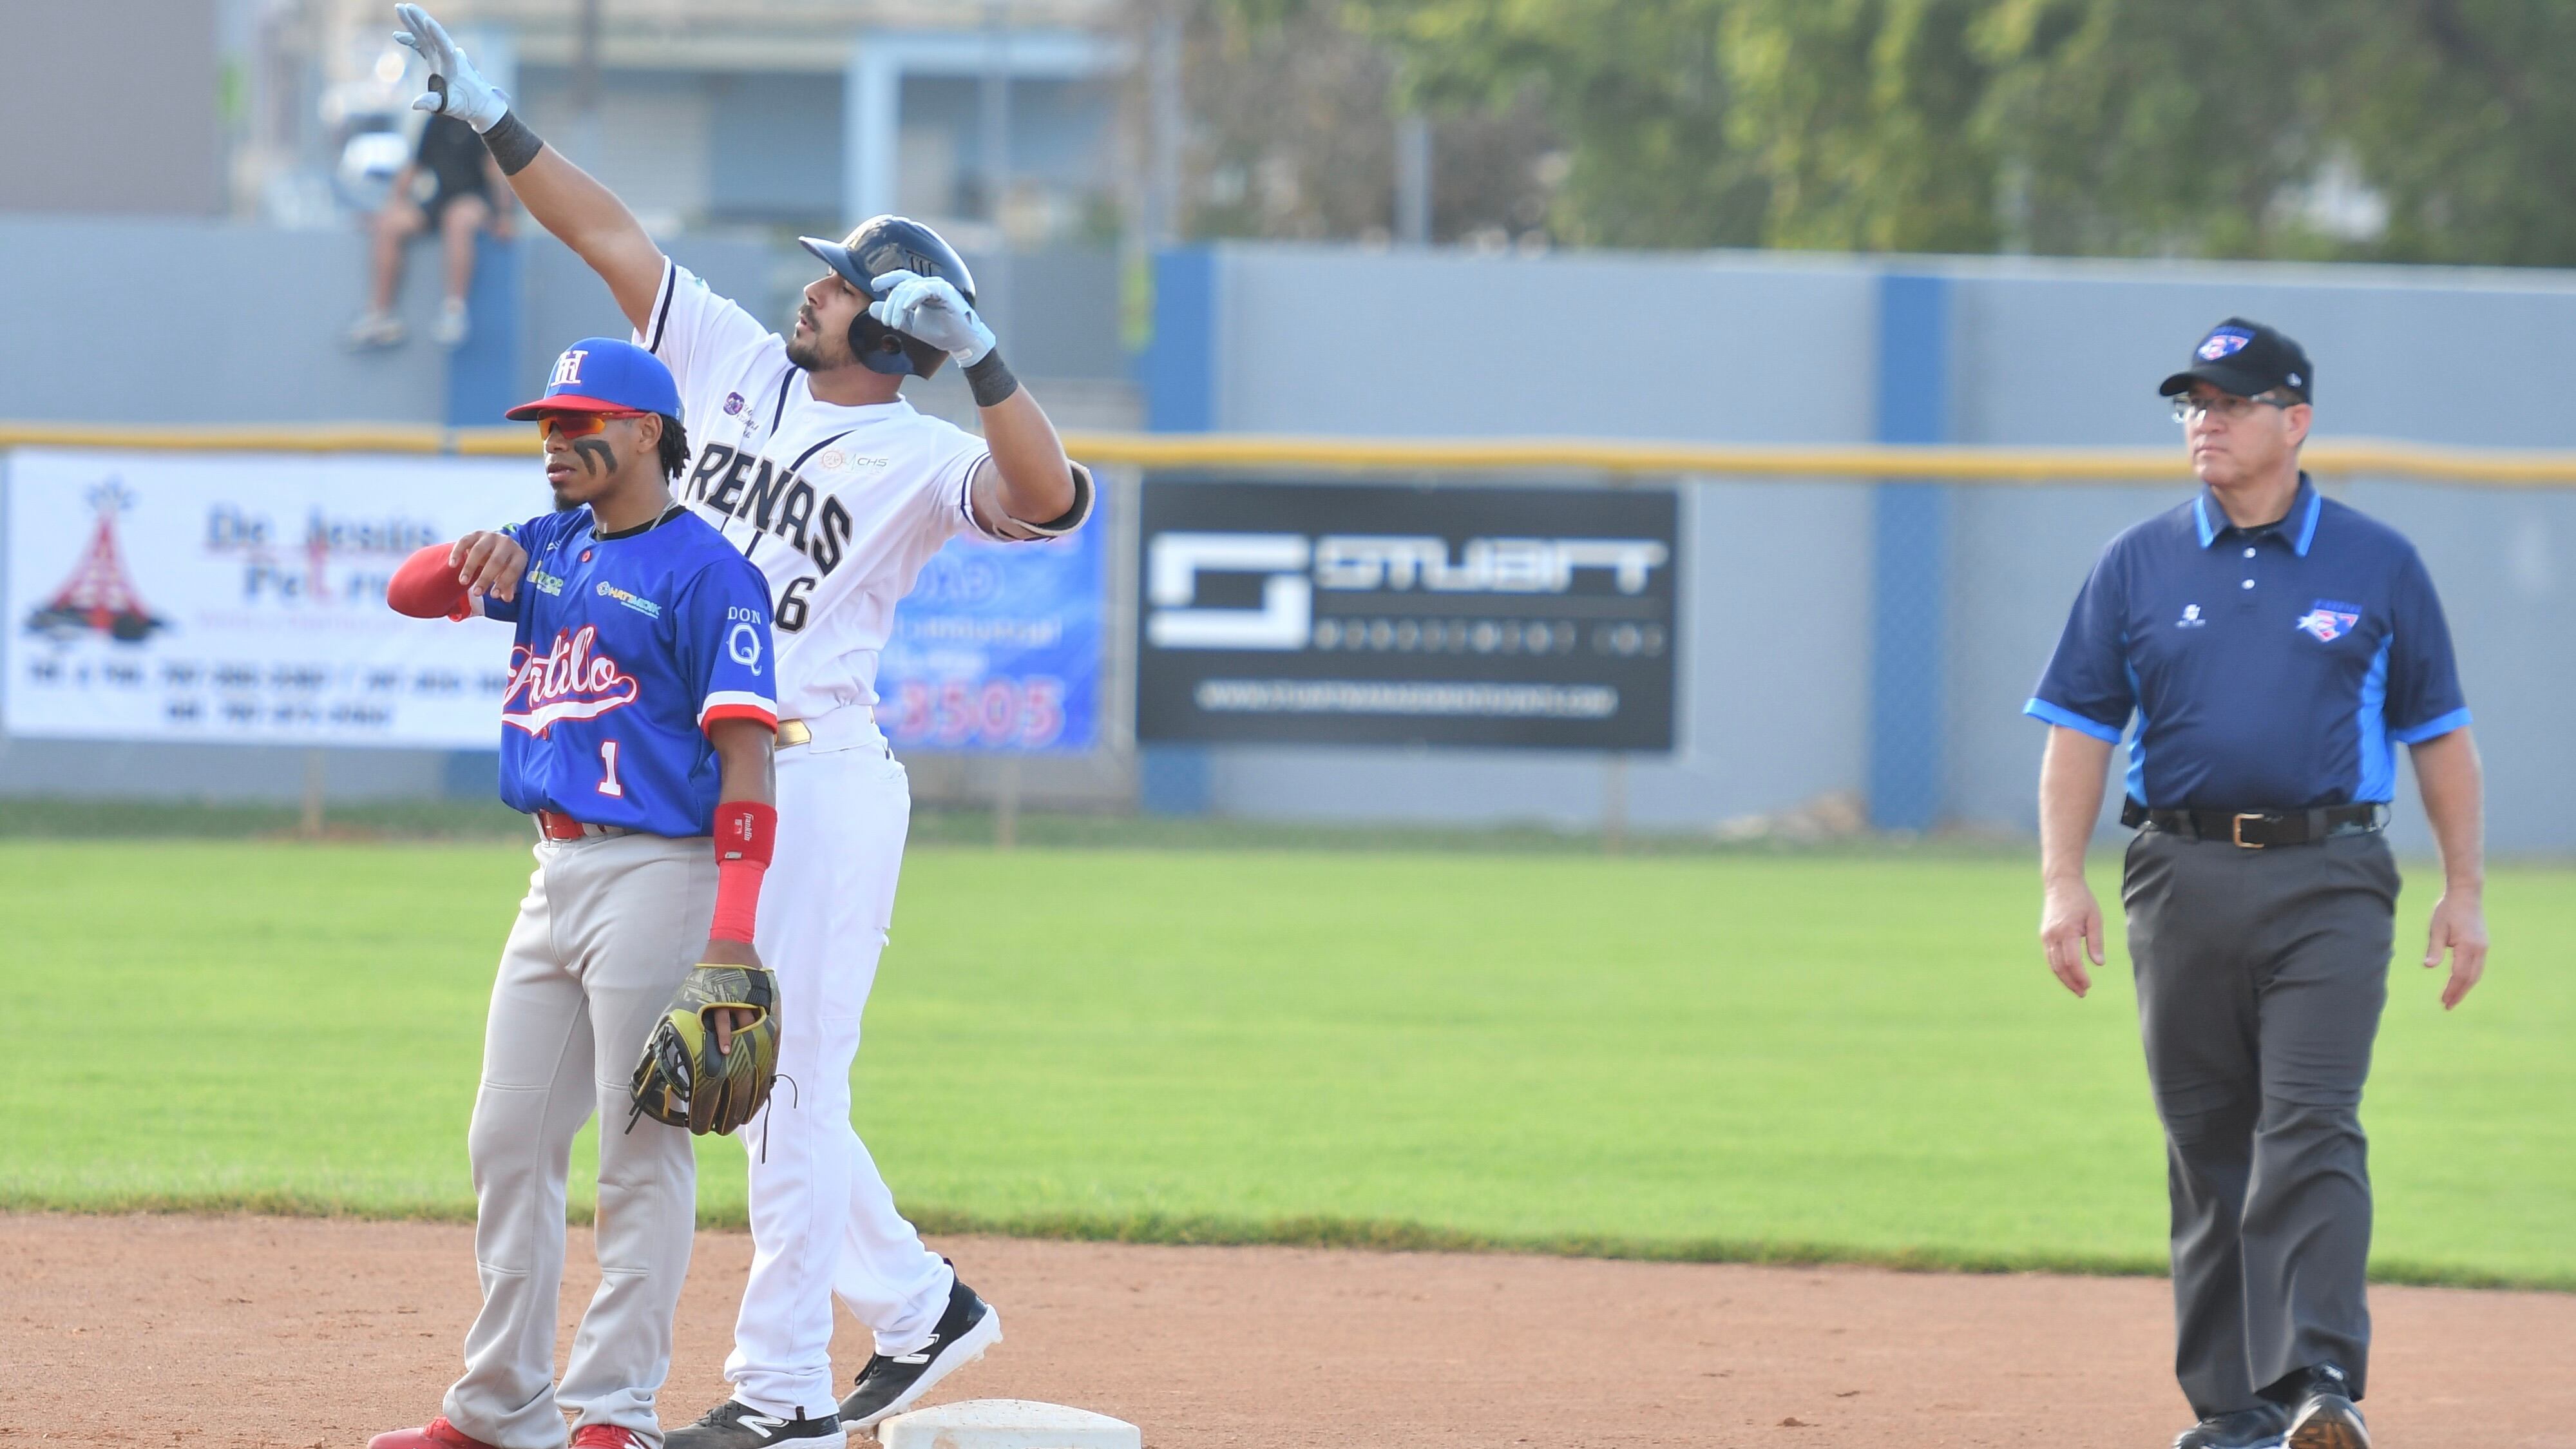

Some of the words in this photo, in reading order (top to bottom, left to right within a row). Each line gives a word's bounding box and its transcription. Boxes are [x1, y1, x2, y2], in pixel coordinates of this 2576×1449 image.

[728, 606, 761, 625] DON
[773, 575, 818, 634] 6
[726, 622, 763, 677] Q
[598, 741, 622, 797] 1
